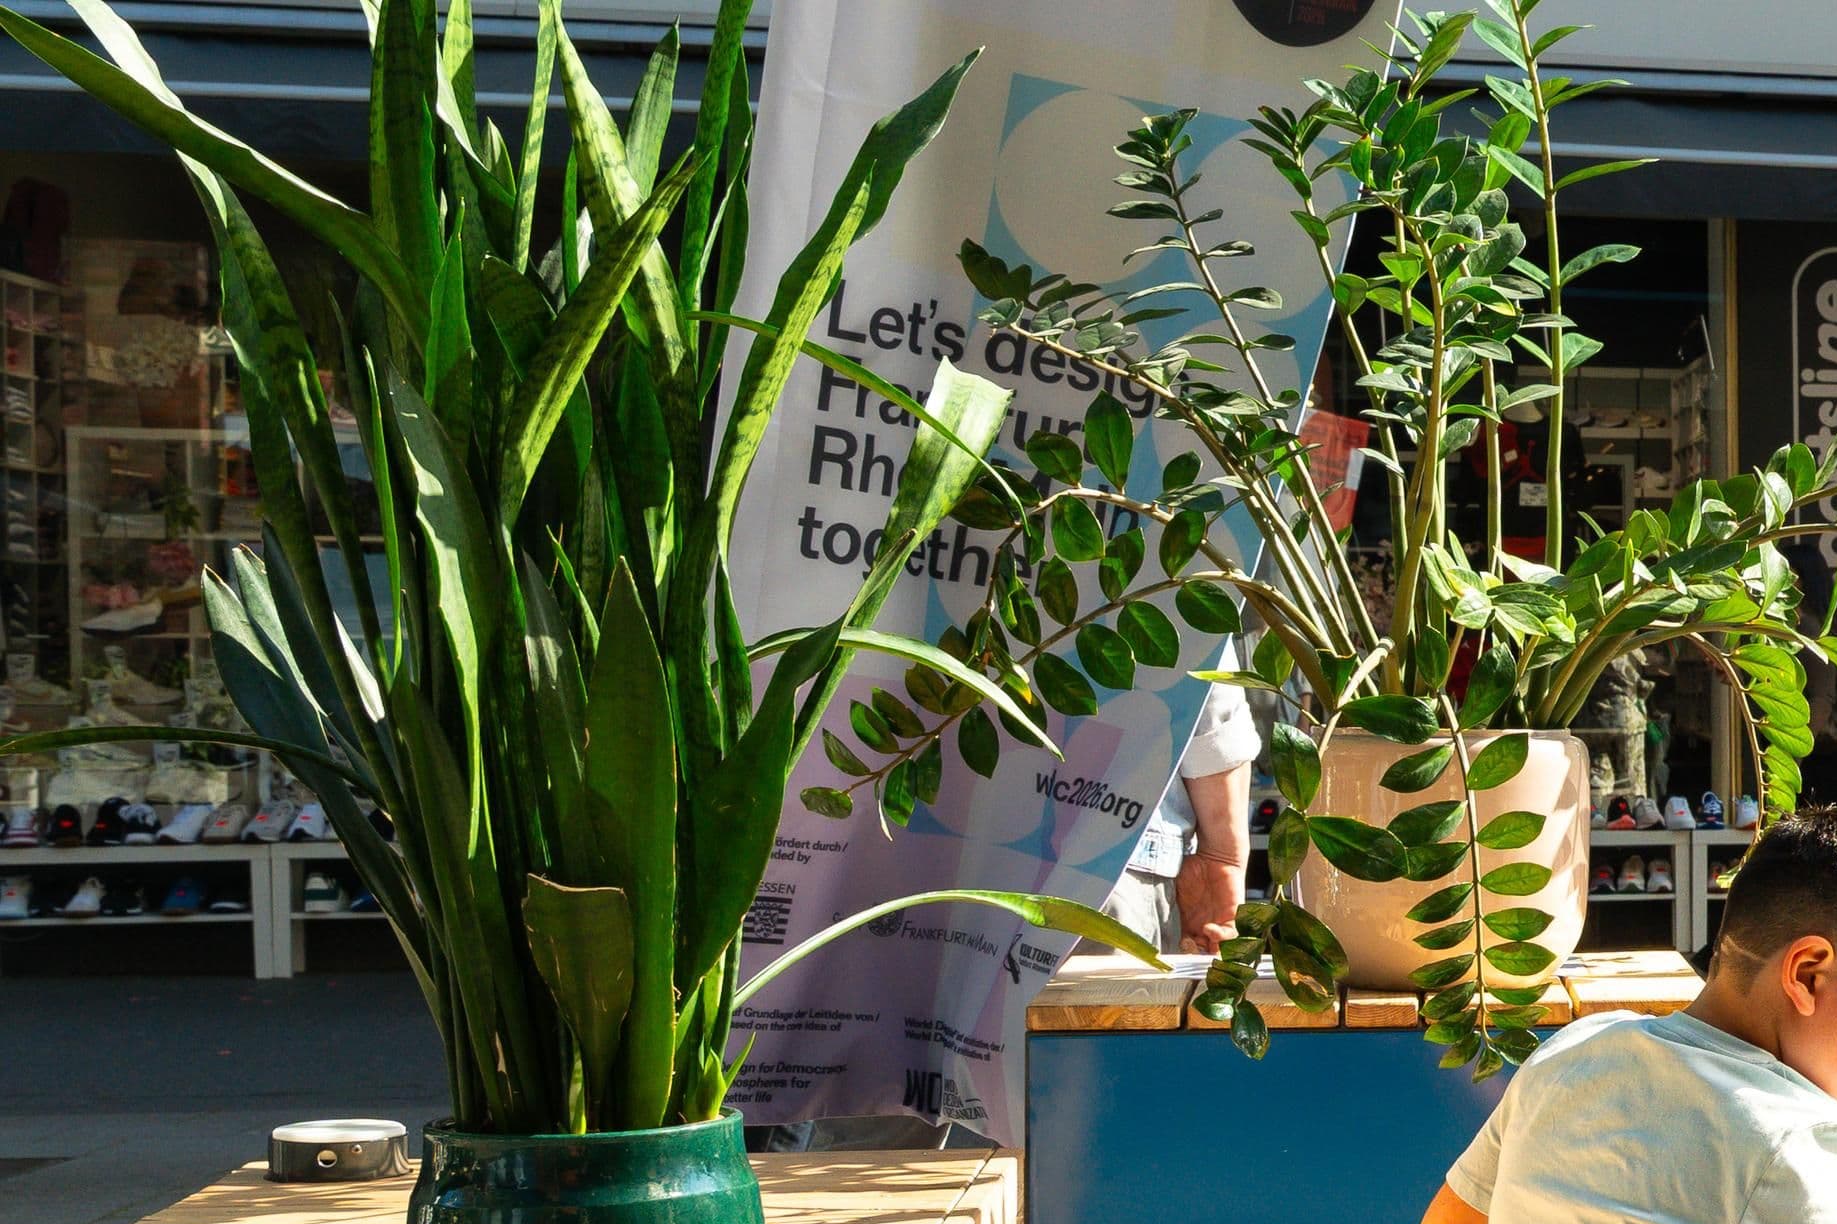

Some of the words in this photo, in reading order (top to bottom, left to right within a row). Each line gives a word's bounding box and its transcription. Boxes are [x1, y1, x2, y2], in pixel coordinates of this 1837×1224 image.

[826, 279, 966, 362] Let's
[775, 836, 810, 850] ördert
[770, 850, 795, 861] ded
[797, 851, 811, 864] by
[758, 881, 797, 895] ESSEN
[730, 1020, 754, 1030] ased
[754, 1023, 769, 1031] on
[770, 1021, 785, 1032] the
[829, 1022, 843, 1032] of
[758, 1063, 776, 1074] for
[790, 1076, 811, 1089] for
[754, 1093, 773, 1103] life
